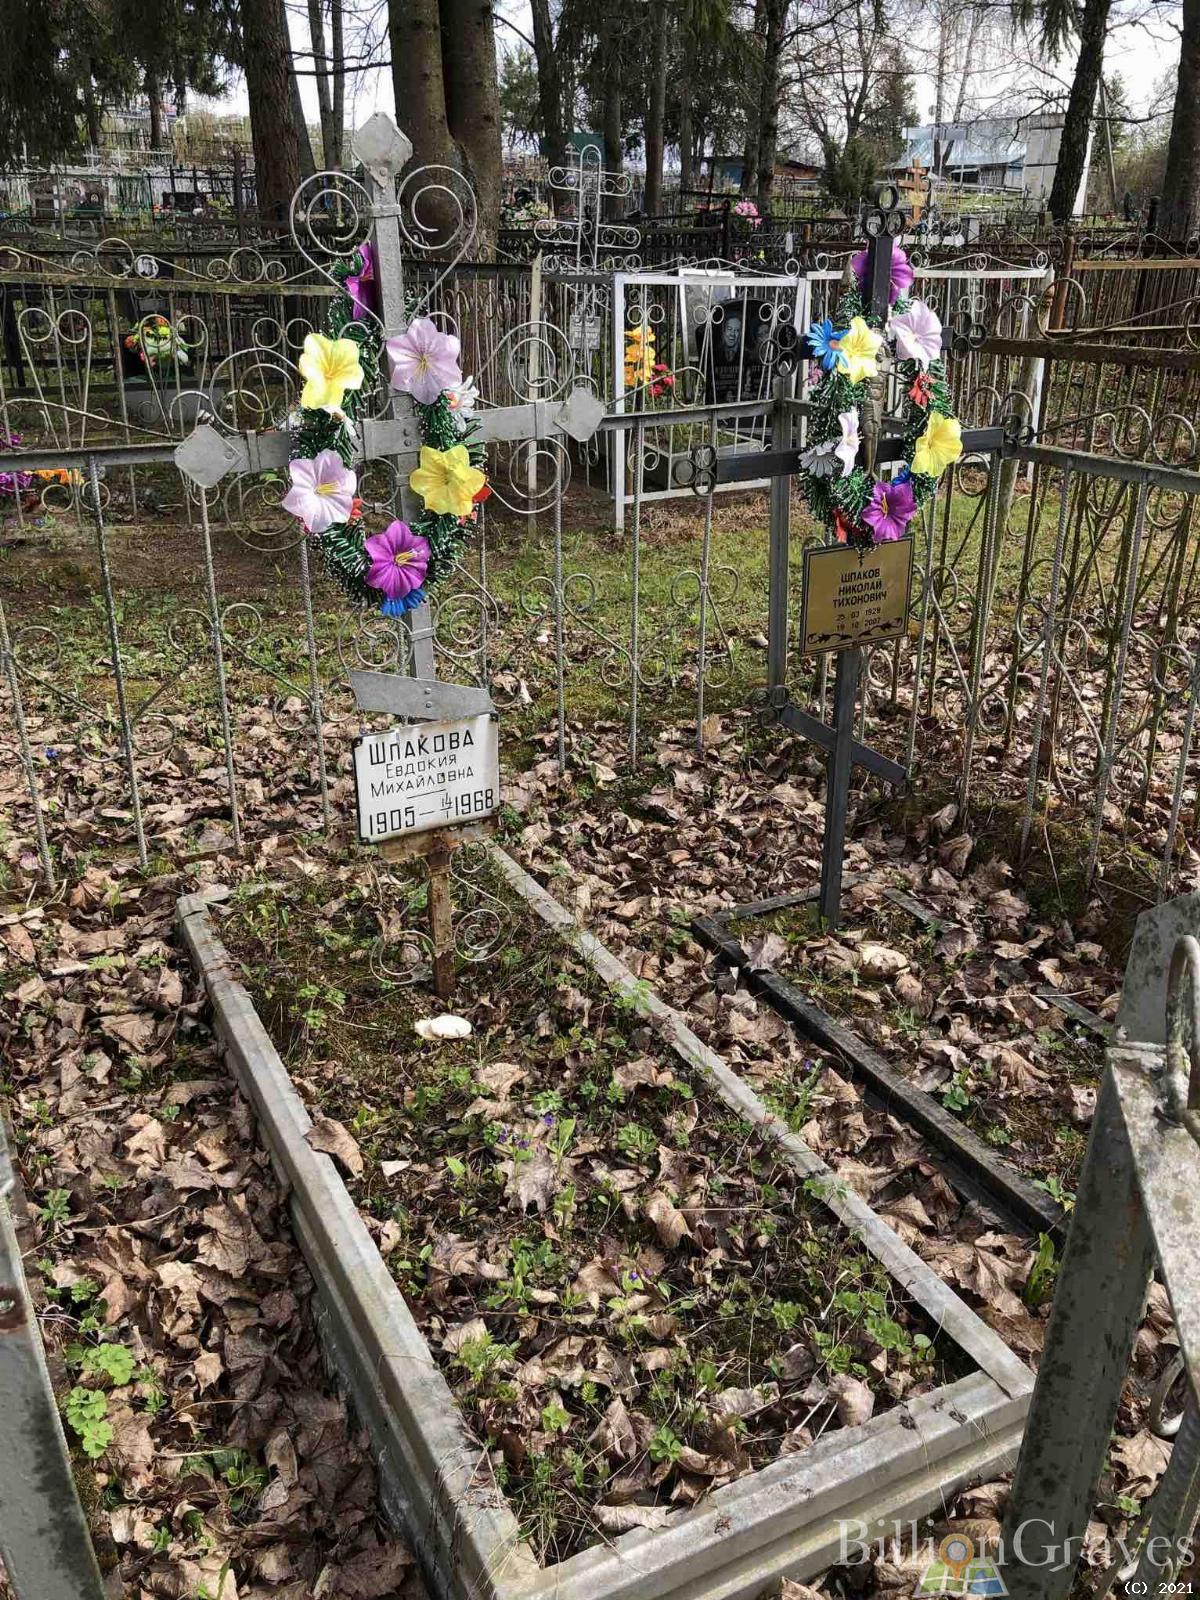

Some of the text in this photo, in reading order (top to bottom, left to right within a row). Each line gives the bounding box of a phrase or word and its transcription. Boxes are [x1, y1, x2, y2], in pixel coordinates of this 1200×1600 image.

[841, 568, 880, 583] ШПАКОВ
[832, 591, 887, 608] ТИХОНОВИЧ
[369, 729, 474, 765] ШПАКОВА
[369, 806, 415, 836] 1905
[455, 788, 494, 816] 1968
